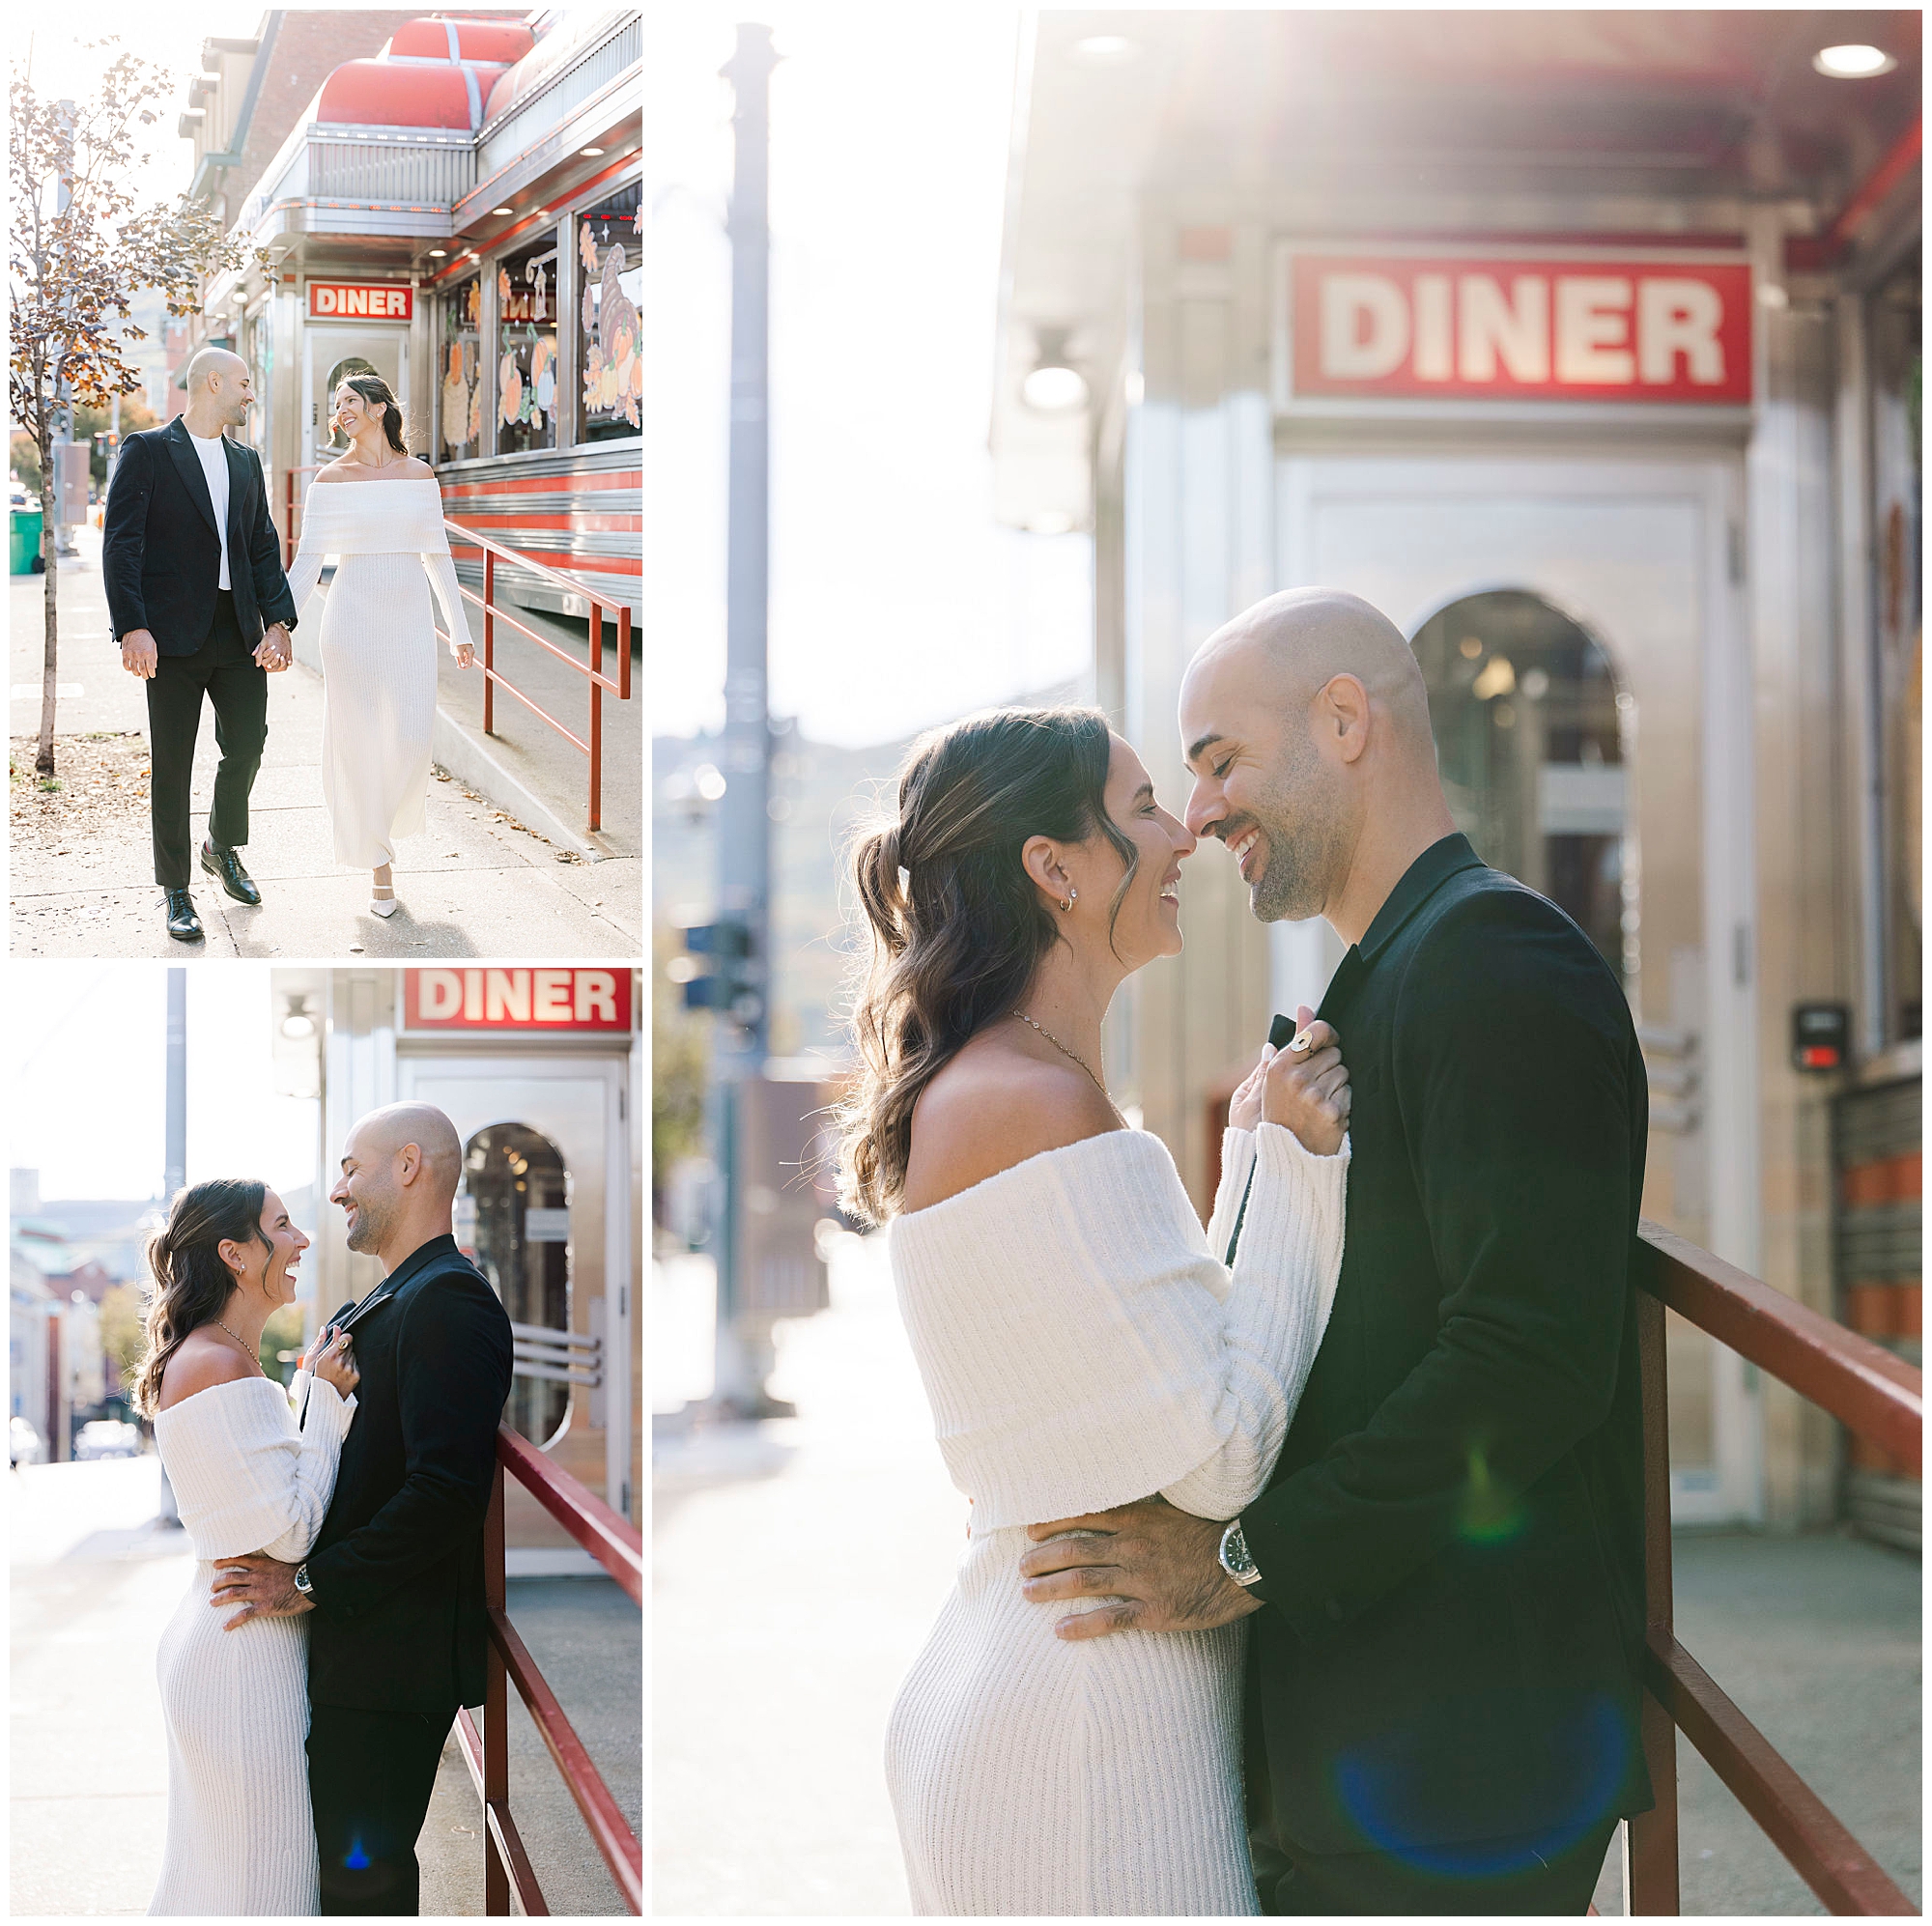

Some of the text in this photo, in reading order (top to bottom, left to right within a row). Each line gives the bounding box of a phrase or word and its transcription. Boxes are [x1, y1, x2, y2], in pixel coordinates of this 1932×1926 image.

[316, 288, 407, 316] DINER
[1320, 274, 1726, 383] DINER
[418, 968, 617, 1022] DINER
